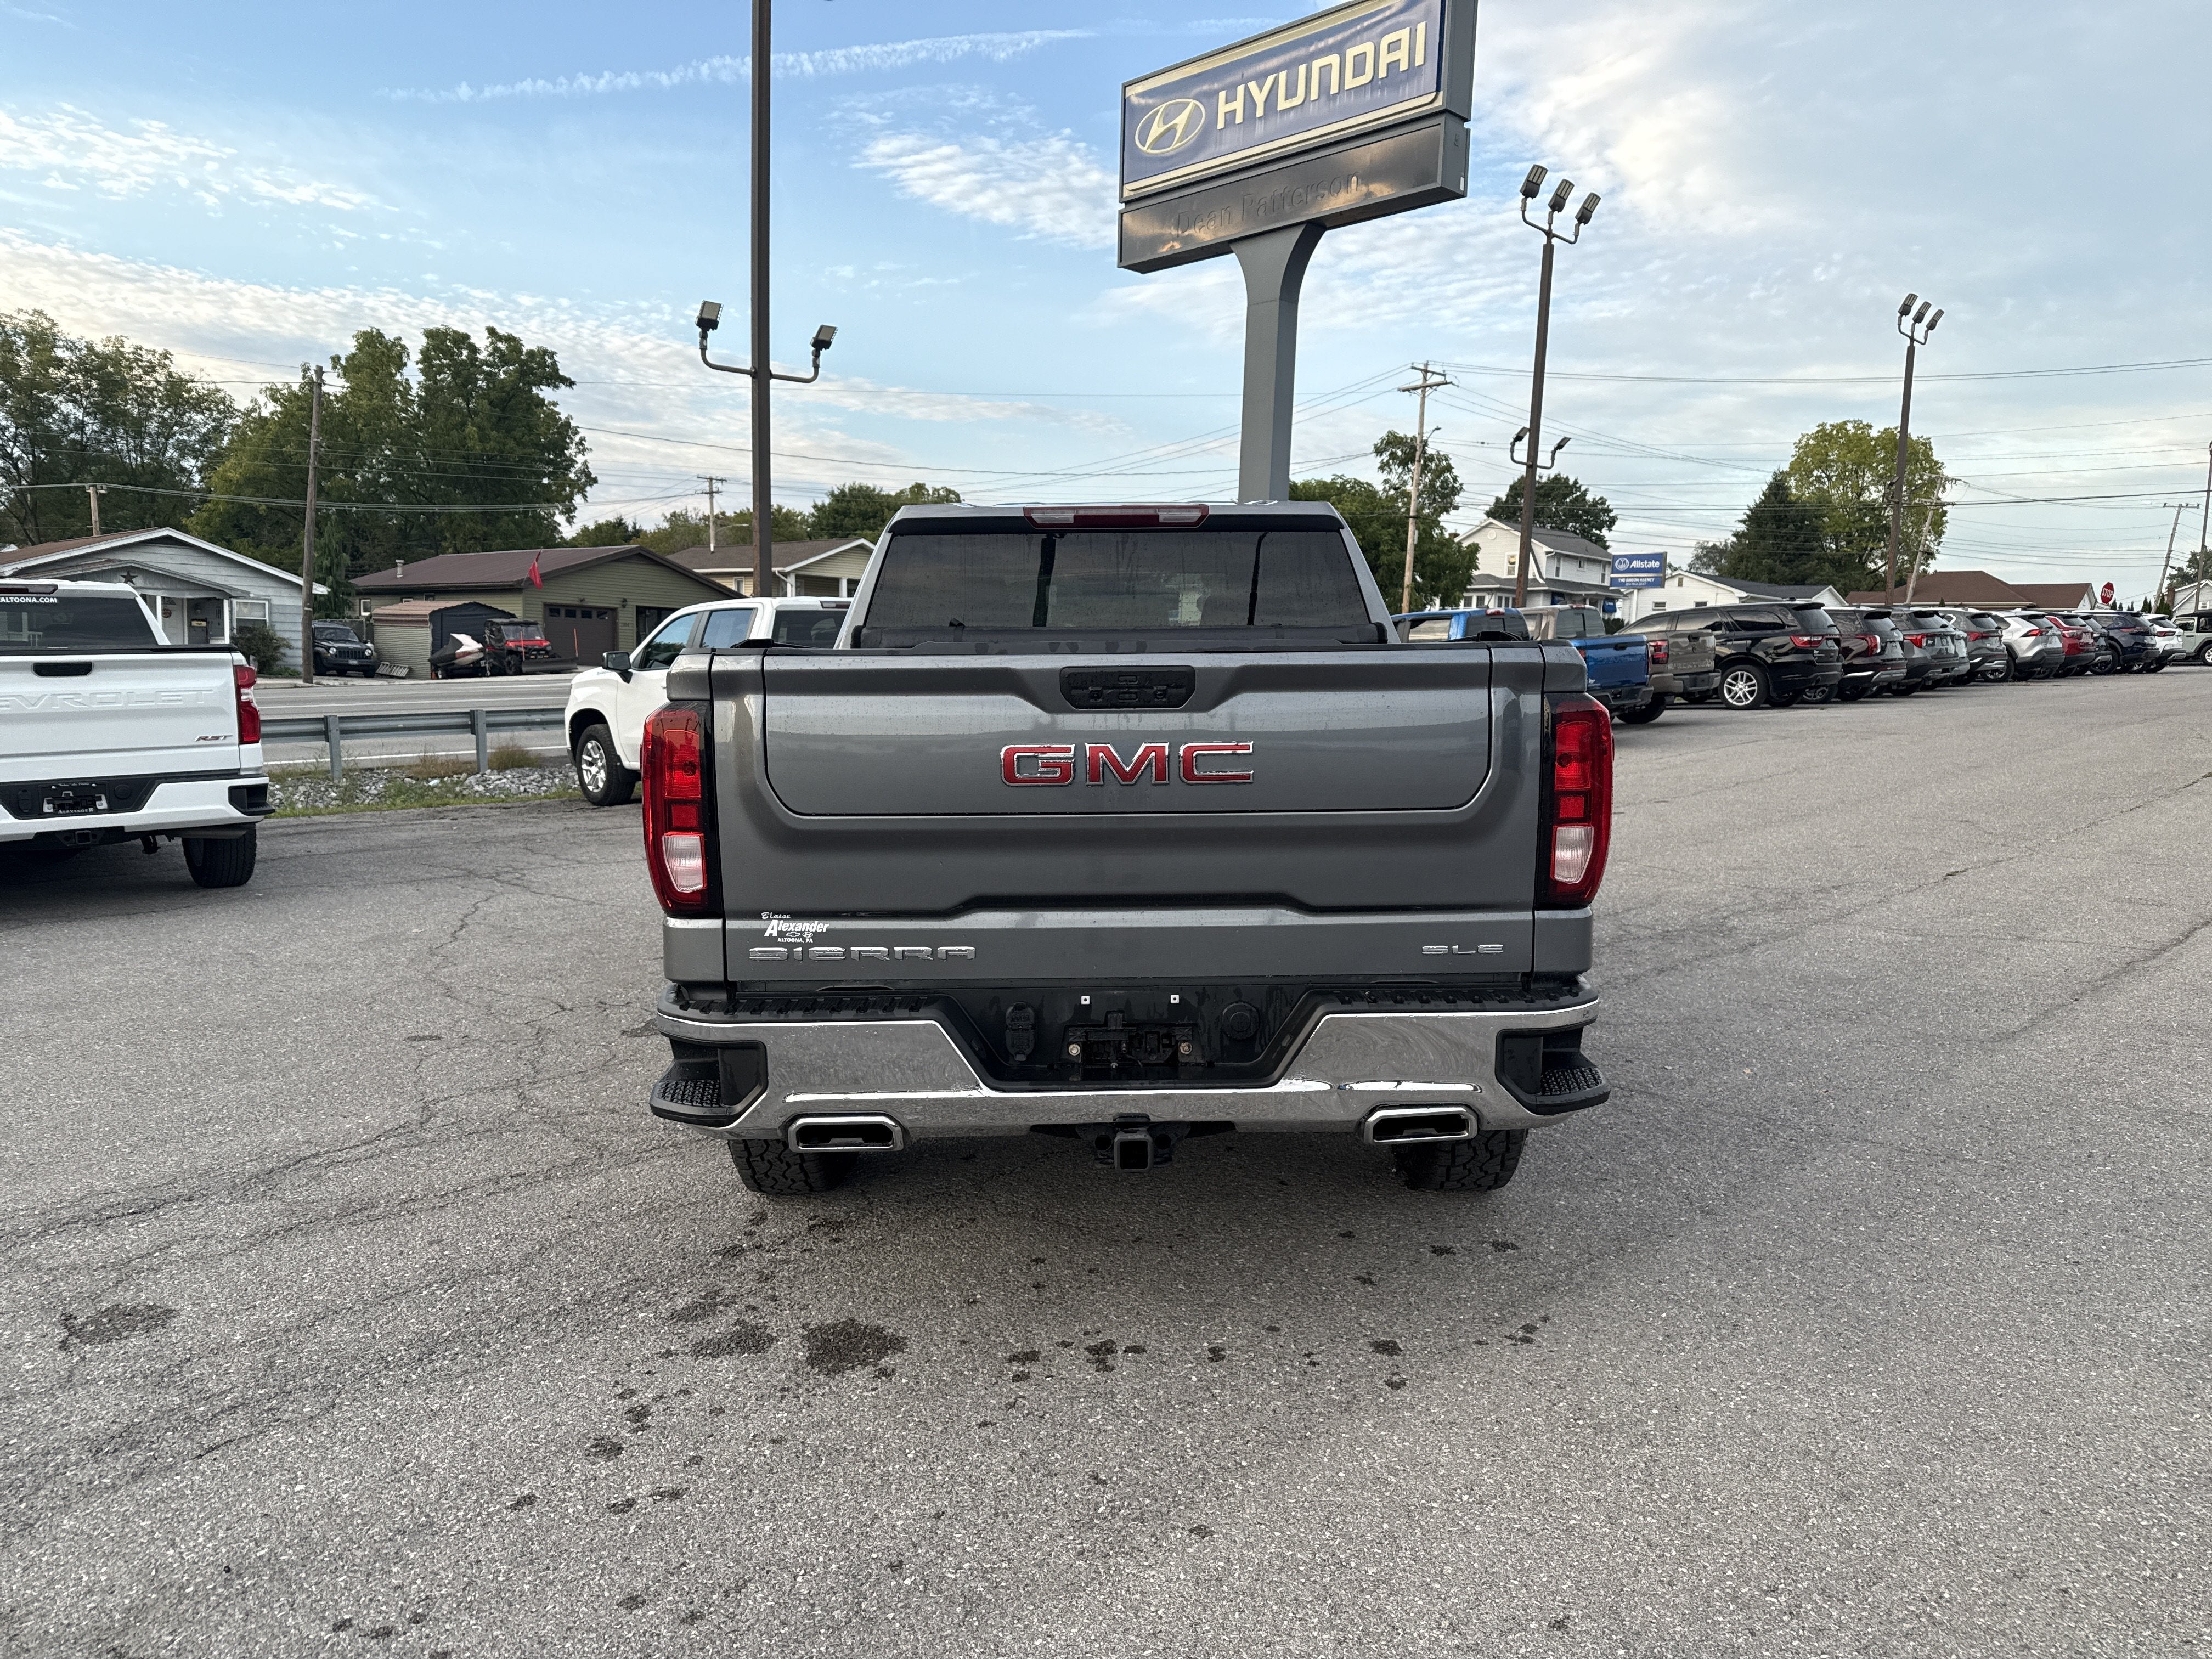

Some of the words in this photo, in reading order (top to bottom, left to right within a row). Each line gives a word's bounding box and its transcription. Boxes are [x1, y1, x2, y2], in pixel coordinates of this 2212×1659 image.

[1217, 21, 1427, 131] HYUNDAI
[1176, 206, 1231, 238] Dean
[1242, 171, 1360, 222] Patterson
[1629, 560, 1660, 568] Allstate
[2101, 588, 2114, 599] STOP
[1000, 741, 1254, 786] GMC
[761, 911, 792, 919] Blaise
[764, 919, 830, 937] Alexander
[749, 946, 976, 961] SIERRA
[1421, 944, 1504, 955] SLE
